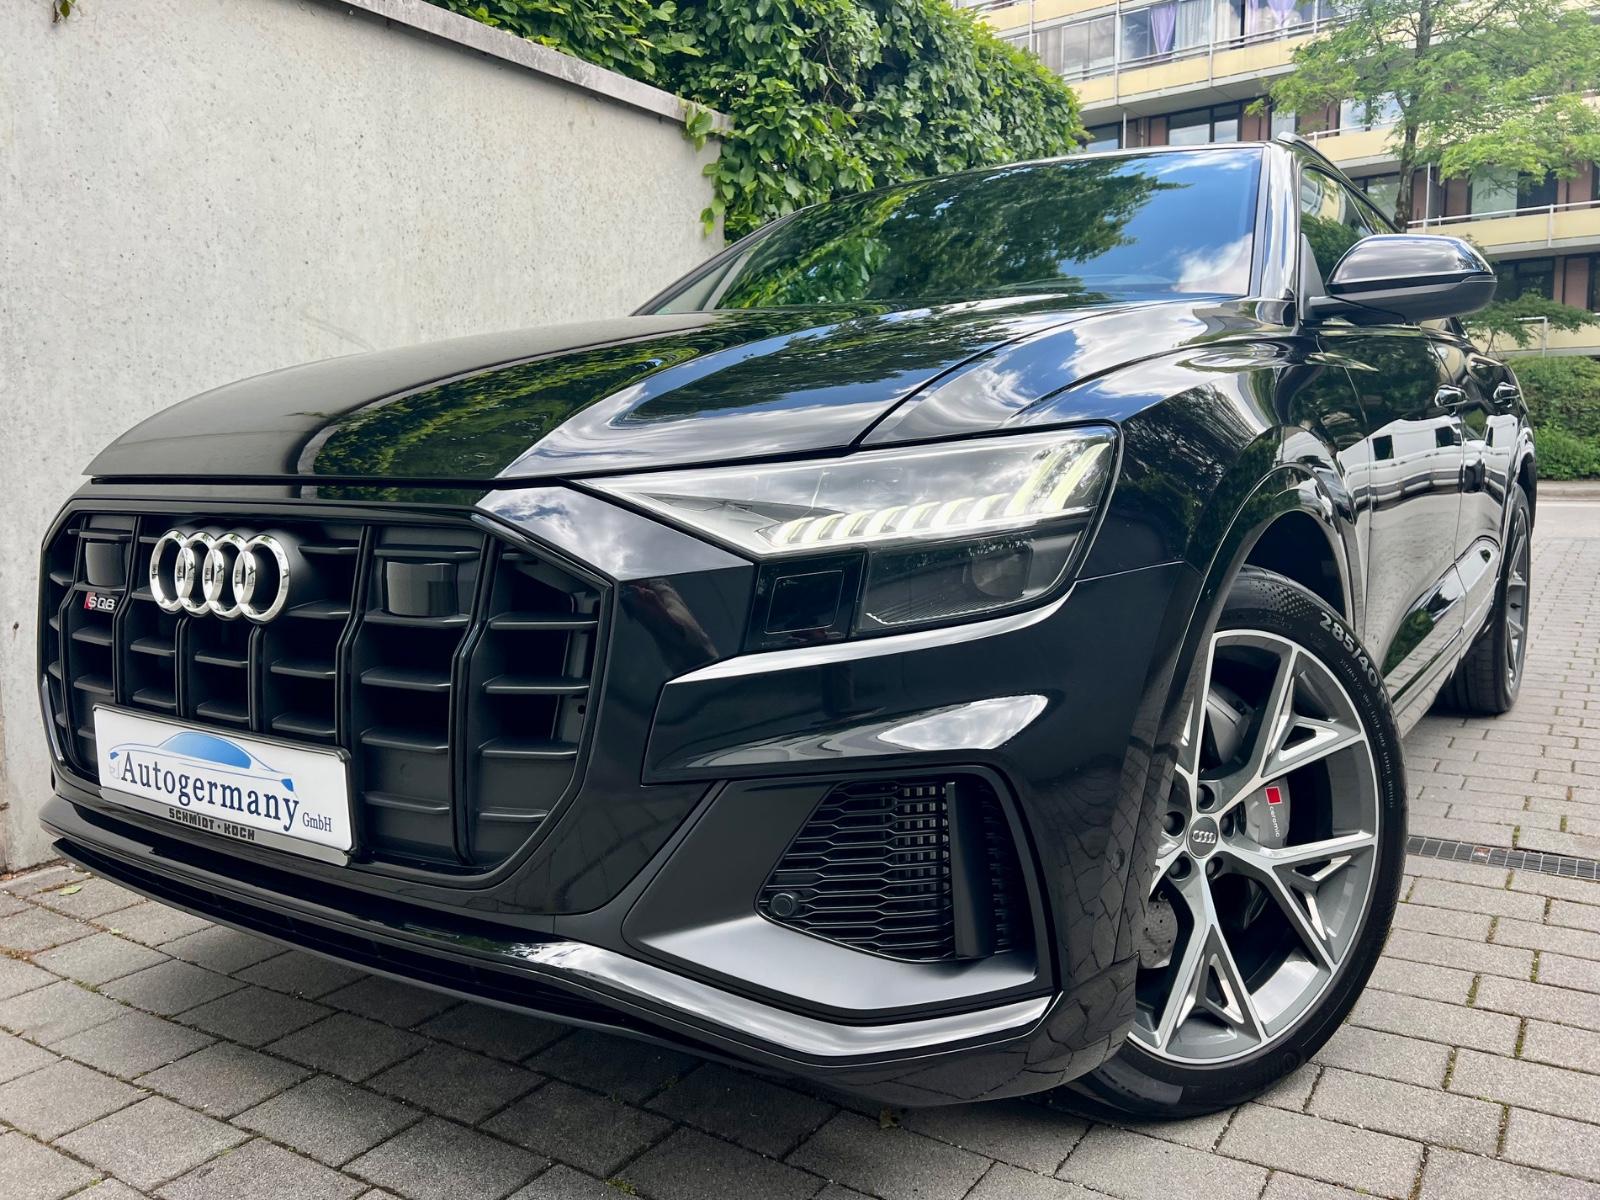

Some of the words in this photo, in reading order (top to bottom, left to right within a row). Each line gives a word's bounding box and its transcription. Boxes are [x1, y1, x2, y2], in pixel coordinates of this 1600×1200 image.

[87, 595, 115, 610] SQ8
[1319, 610, 1379, 688] 285/40
[121, 751, 300, 832] Autogermany
[302, 812, 332, 833] GmbH
[168, 806, 215, 830] SCHMIDT
[224, 822, 256, 841] KOCH
[1269, 805, 1281, 838] ceramic
